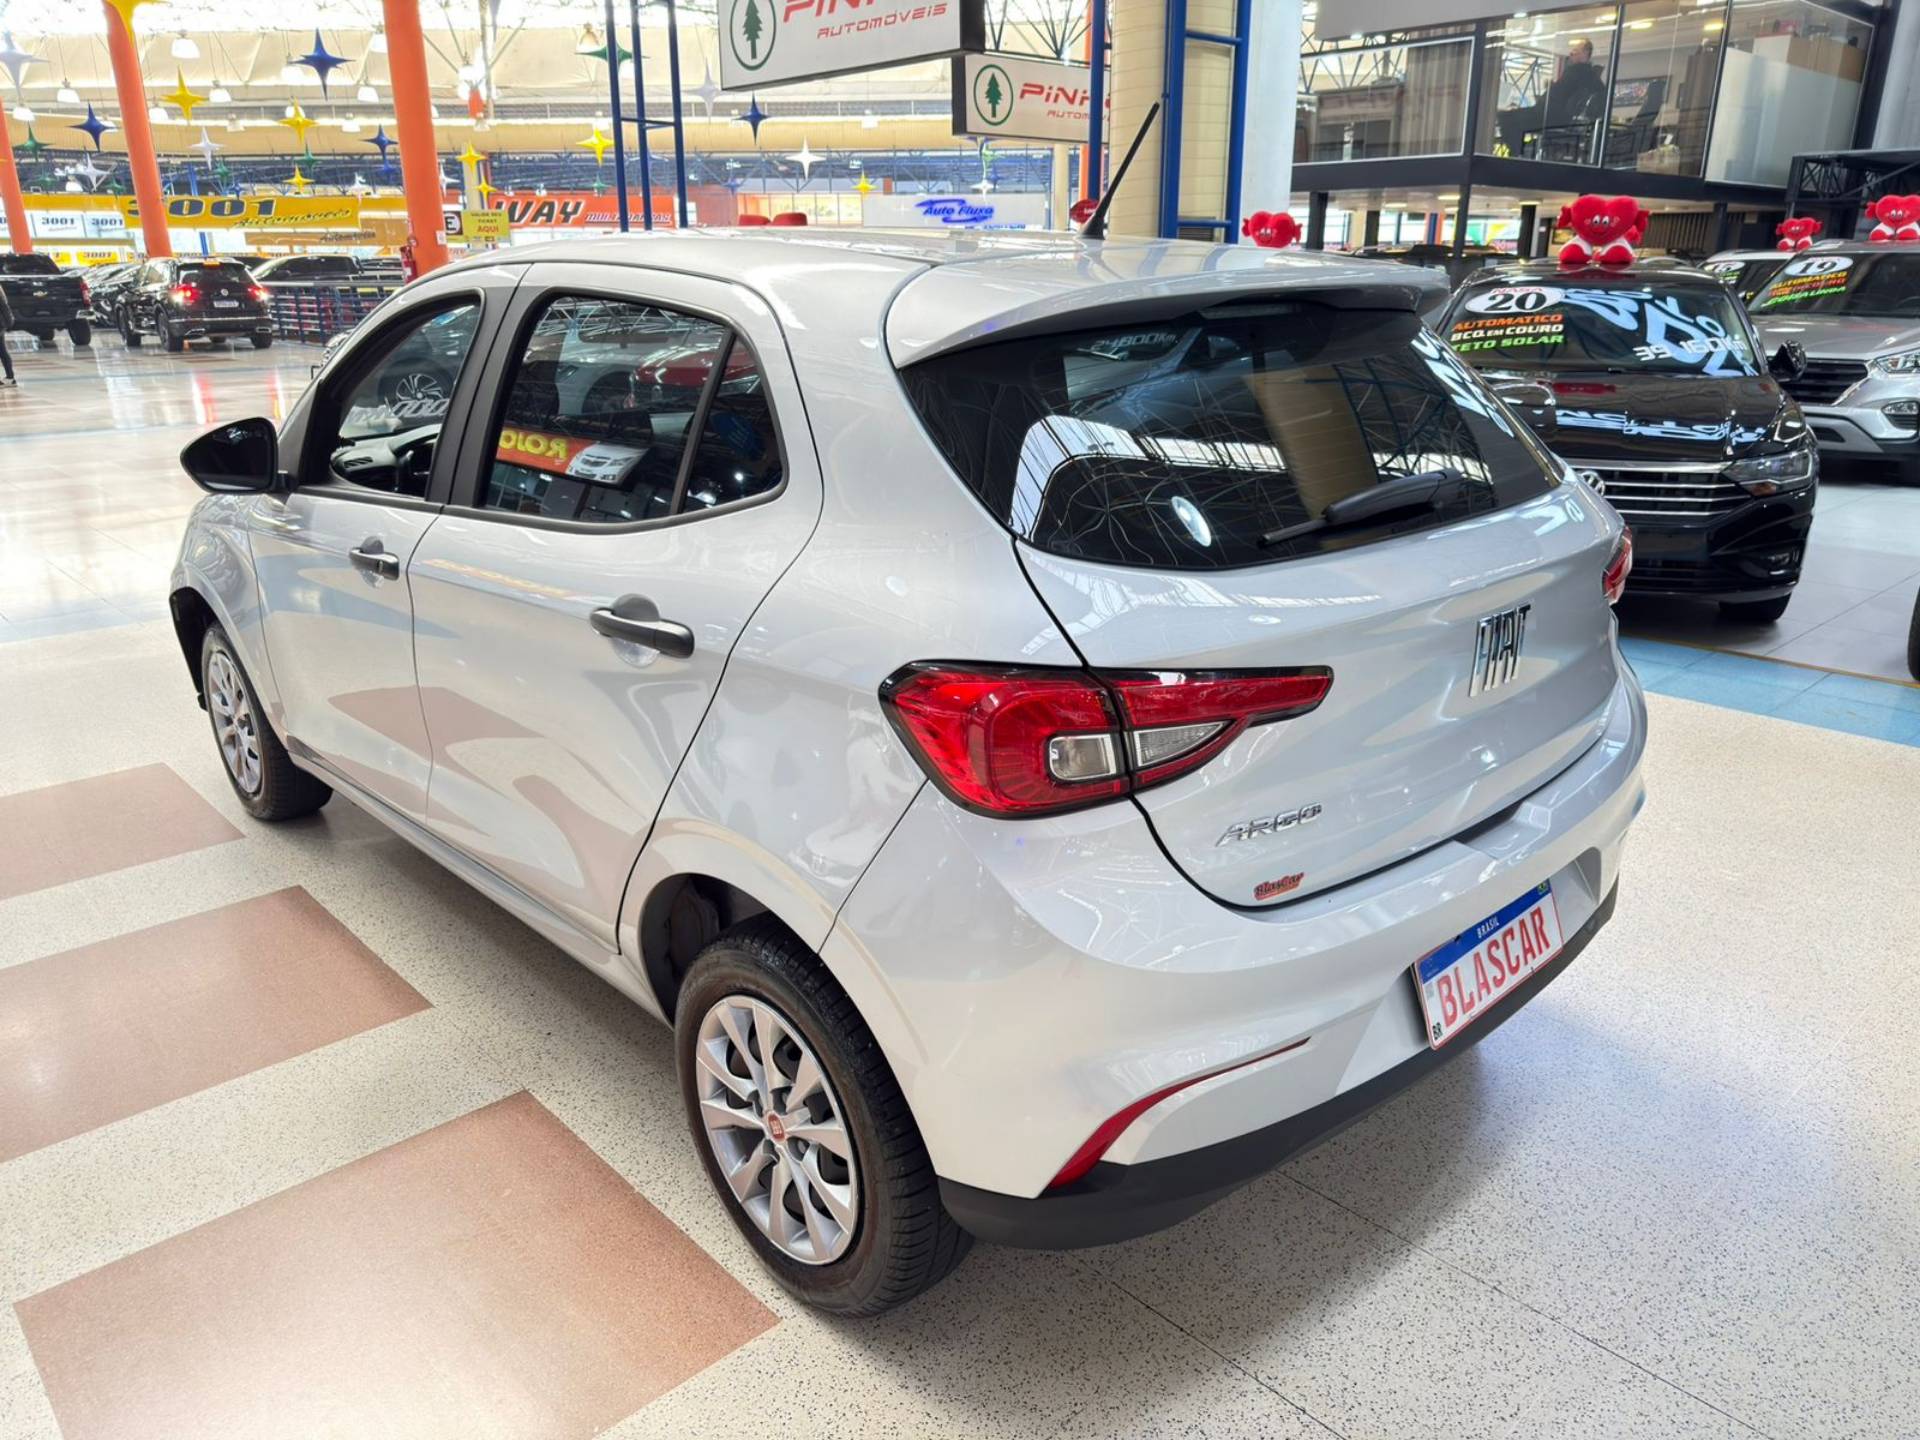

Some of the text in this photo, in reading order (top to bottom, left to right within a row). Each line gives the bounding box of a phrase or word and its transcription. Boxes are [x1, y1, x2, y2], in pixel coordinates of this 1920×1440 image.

[923, 205, 955, 216] Auto
[445, 215, 457, 231] E
[1799, 261, 1837, 274] 19
[1484, 292, 1548, 312] 20
[1453, 314, 1564, 332] AUTOMATICO
[1501, 335, 1565, 348] SOLAR
[1469, 604, 1532, 698] FIAT
[1215, 802, 1322, 847] ARGO
[1476, 916, 1500, 939] BRASIL
[1437, 906, 1551, 1028] BLASCAR
[1432, 1022, 1444, 1041] BR
